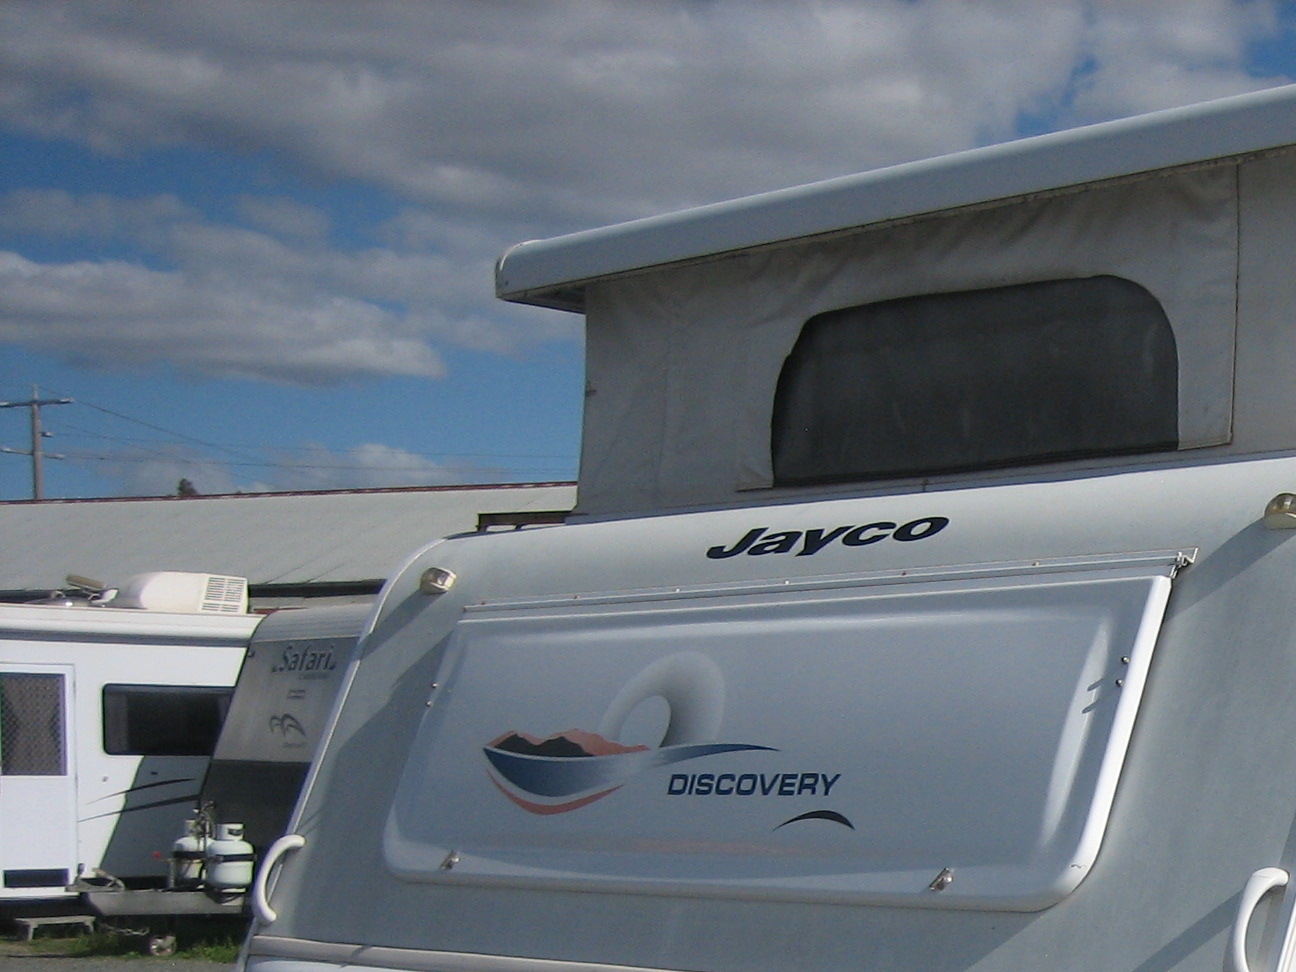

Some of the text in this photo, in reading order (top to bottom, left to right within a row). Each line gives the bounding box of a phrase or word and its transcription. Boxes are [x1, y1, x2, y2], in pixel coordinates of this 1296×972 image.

[706, 516, 950, 560] Jayco
[278, 644, 335, 673] Safari
[667, 772, 842, 797] DISCOVERY
